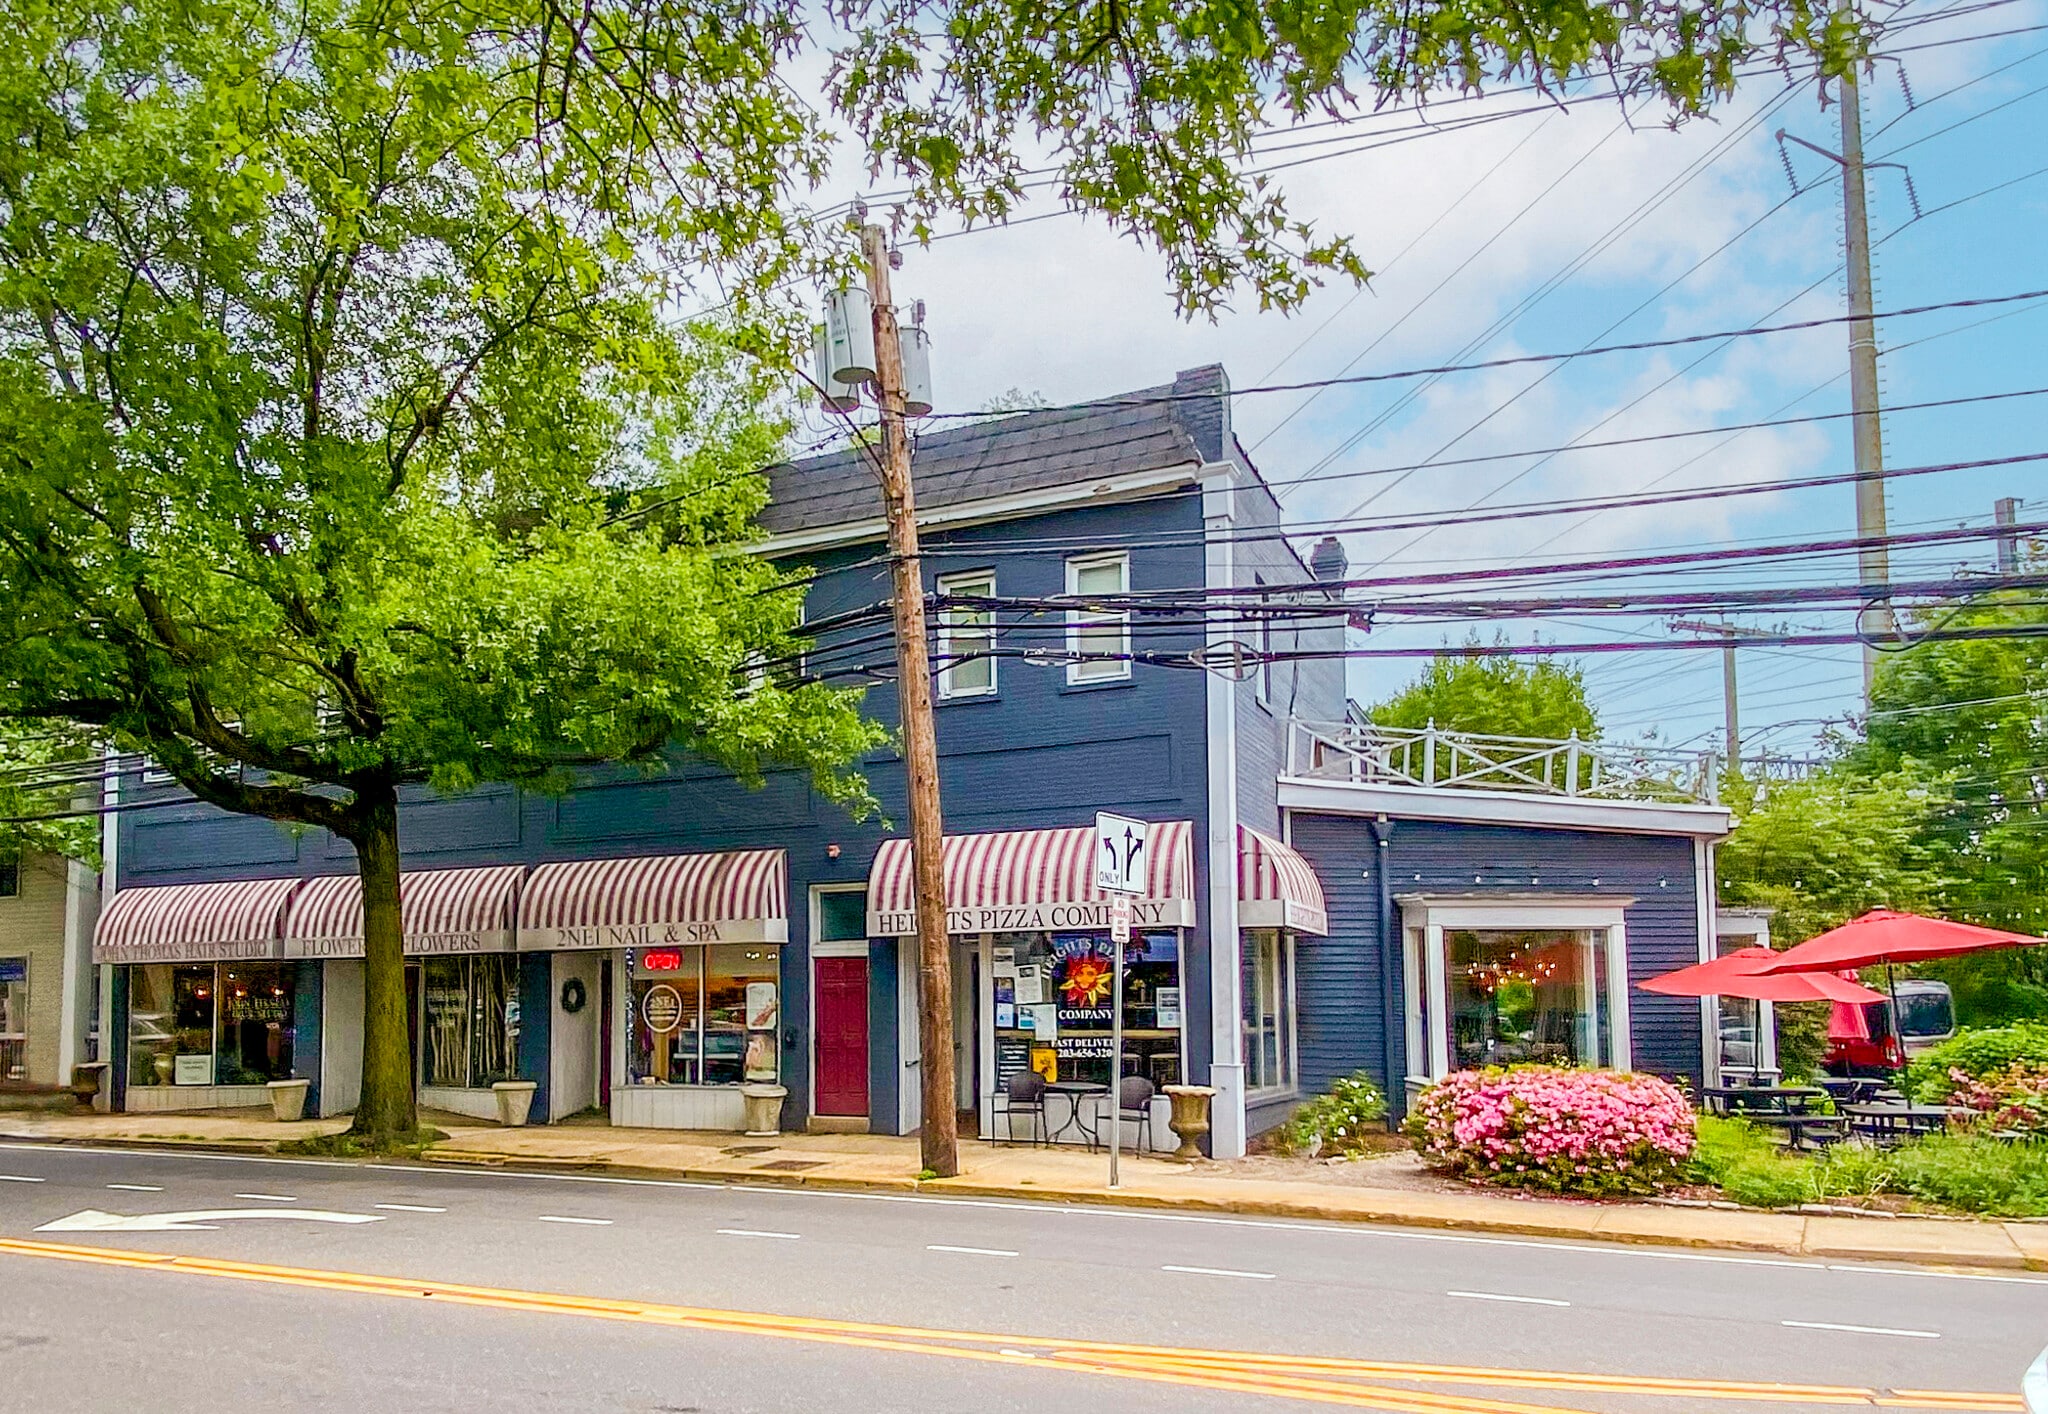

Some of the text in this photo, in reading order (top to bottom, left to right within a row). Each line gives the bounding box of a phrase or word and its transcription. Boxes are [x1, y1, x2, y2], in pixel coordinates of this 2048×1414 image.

[1099, 871, 1120, 884] ONLY
[879, 911, 972, 933] HEITS
[980, 908, 1043, 931] PIZZA
[1051, 903, 1166, 928] COMPNY
[609, 926, 656, 945] NAIL
[664, 926, 680, 943] &
[687, 923, 721, 942] SPA
[133, 944, 182, 961] THOMAS
[185, 943, 215, 959] HAIR
[219, 940, 267, 958] STUDIO
[646, 956, 679, 970] OPEN
[1058, 1009, 1114, 1020] COMPANY
[1051, 1039, 1073, 1047] FAST
